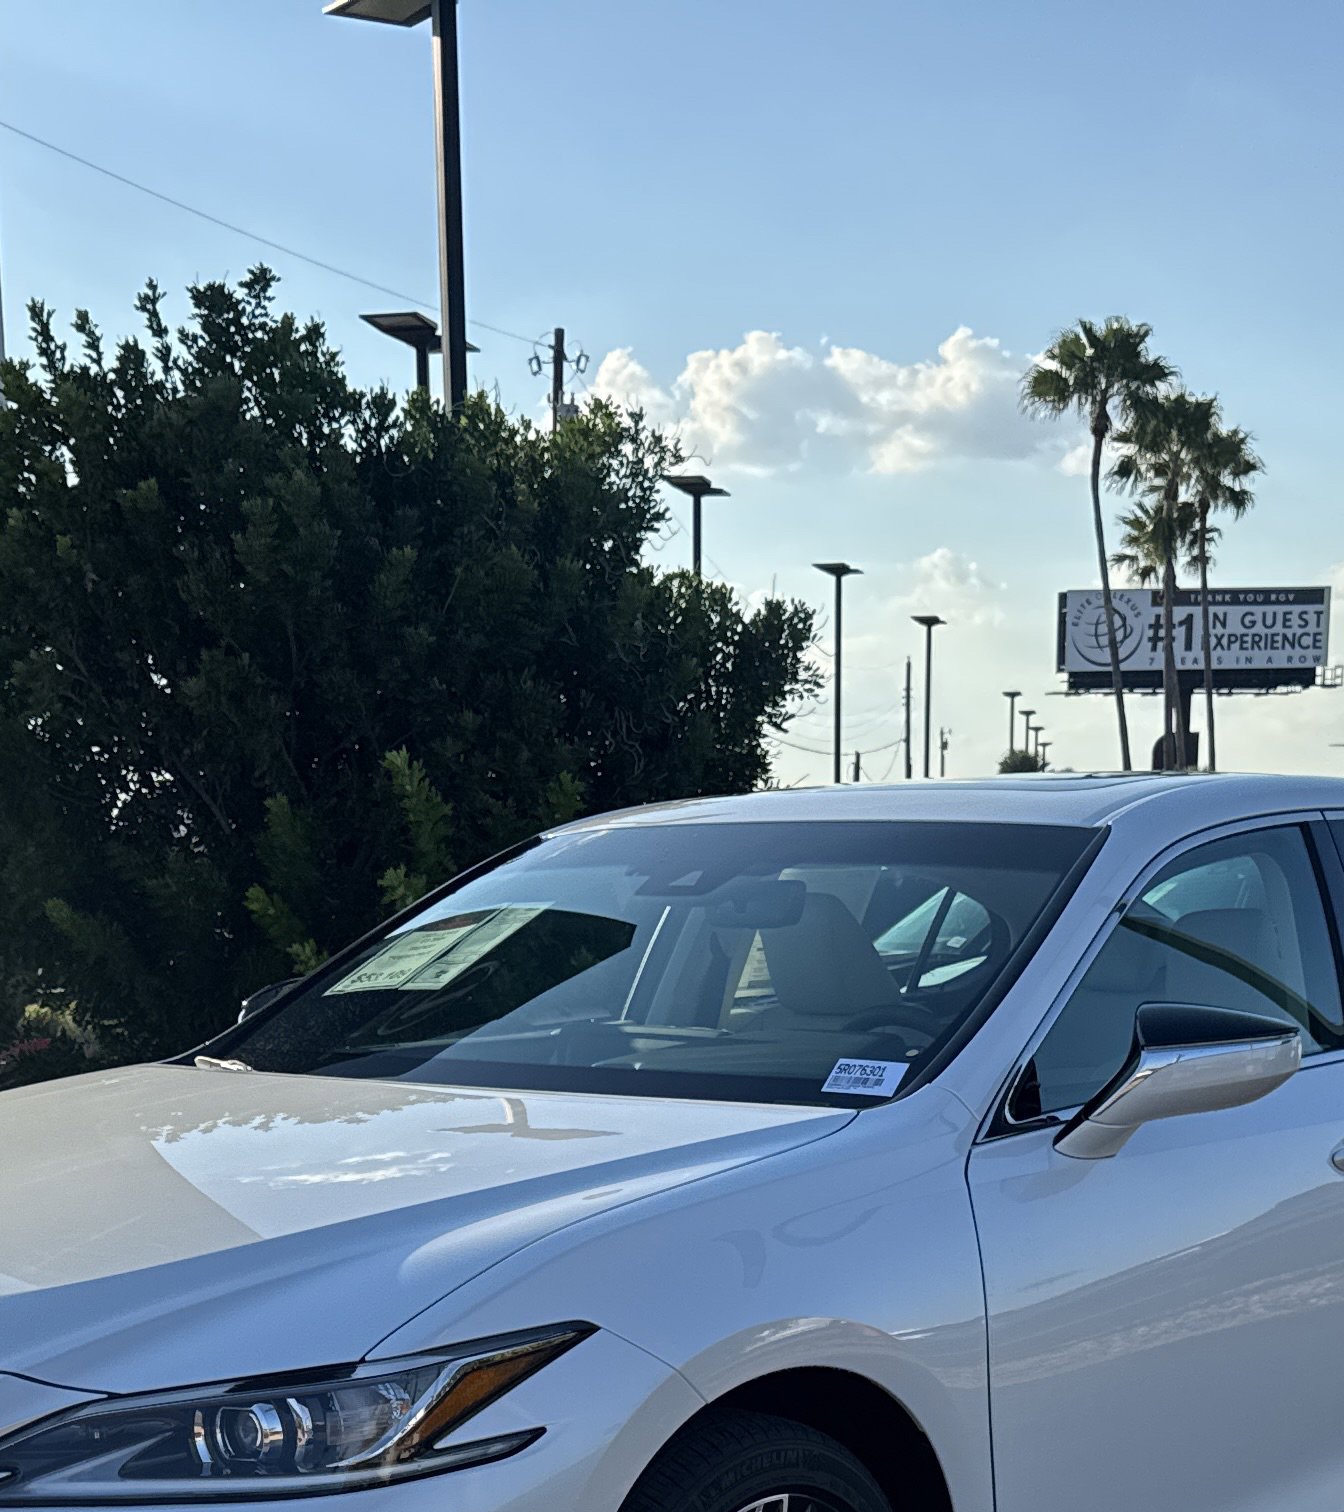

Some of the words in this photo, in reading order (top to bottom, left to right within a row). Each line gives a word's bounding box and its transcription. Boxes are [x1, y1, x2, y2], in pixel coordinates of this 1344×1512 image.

[1112, 591, 1141, 618] LEXUS
[1238, 593, 1264, 603] YOU
[1147, 613, 1194, 653] #1
[1240, 610, 1324, 630] GUEST
[1149, 657, 1156, 666] 7
[1235, 655, 1253, 665] IN
[1266, 655, 1274, 665] A
[1286, 654, 1322, 665] ROW
[834, 1063, 888, 1078] 5R076301
